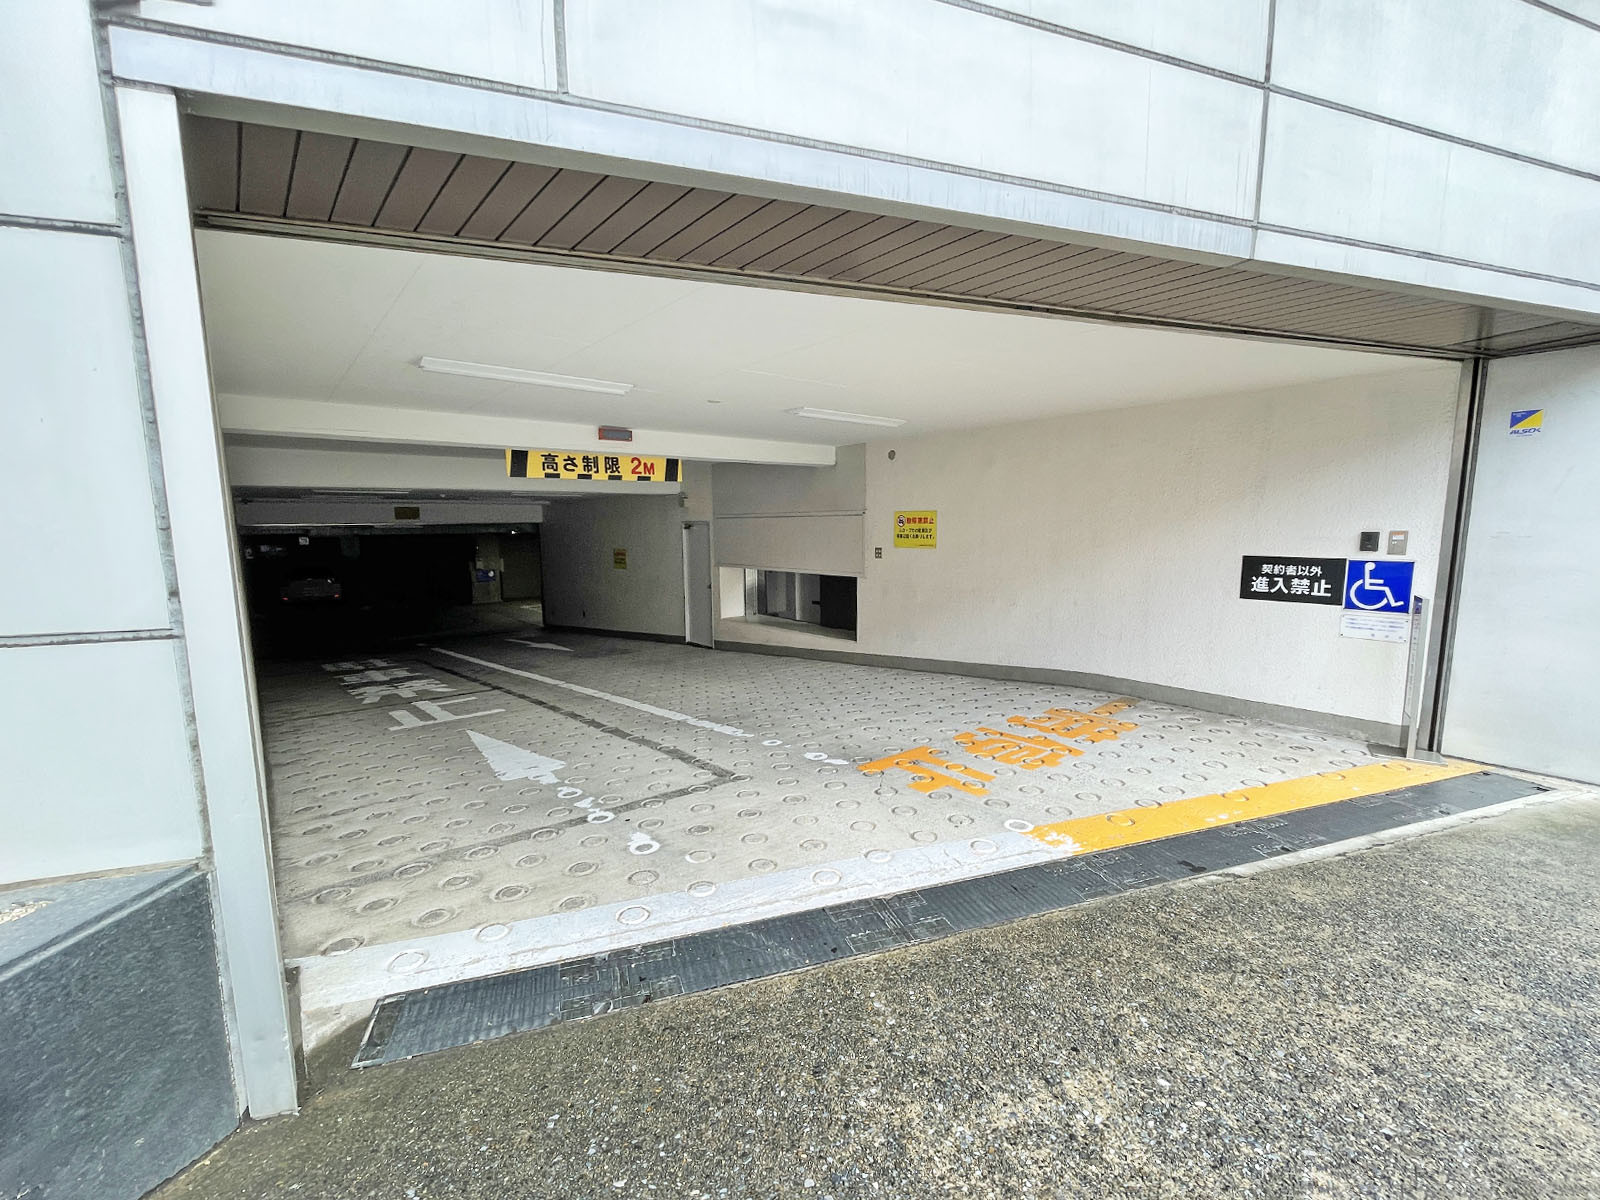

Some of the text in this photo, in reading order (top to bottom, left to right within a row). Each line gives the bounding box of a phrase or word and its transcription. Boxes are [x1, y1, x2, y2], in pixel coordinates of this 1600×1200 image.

[541, 453, 621, 474] 高さ制限
[1261, 564, 1323, 578] 契約者以外
[1250, 576, 1332, 598] 進入禁止
